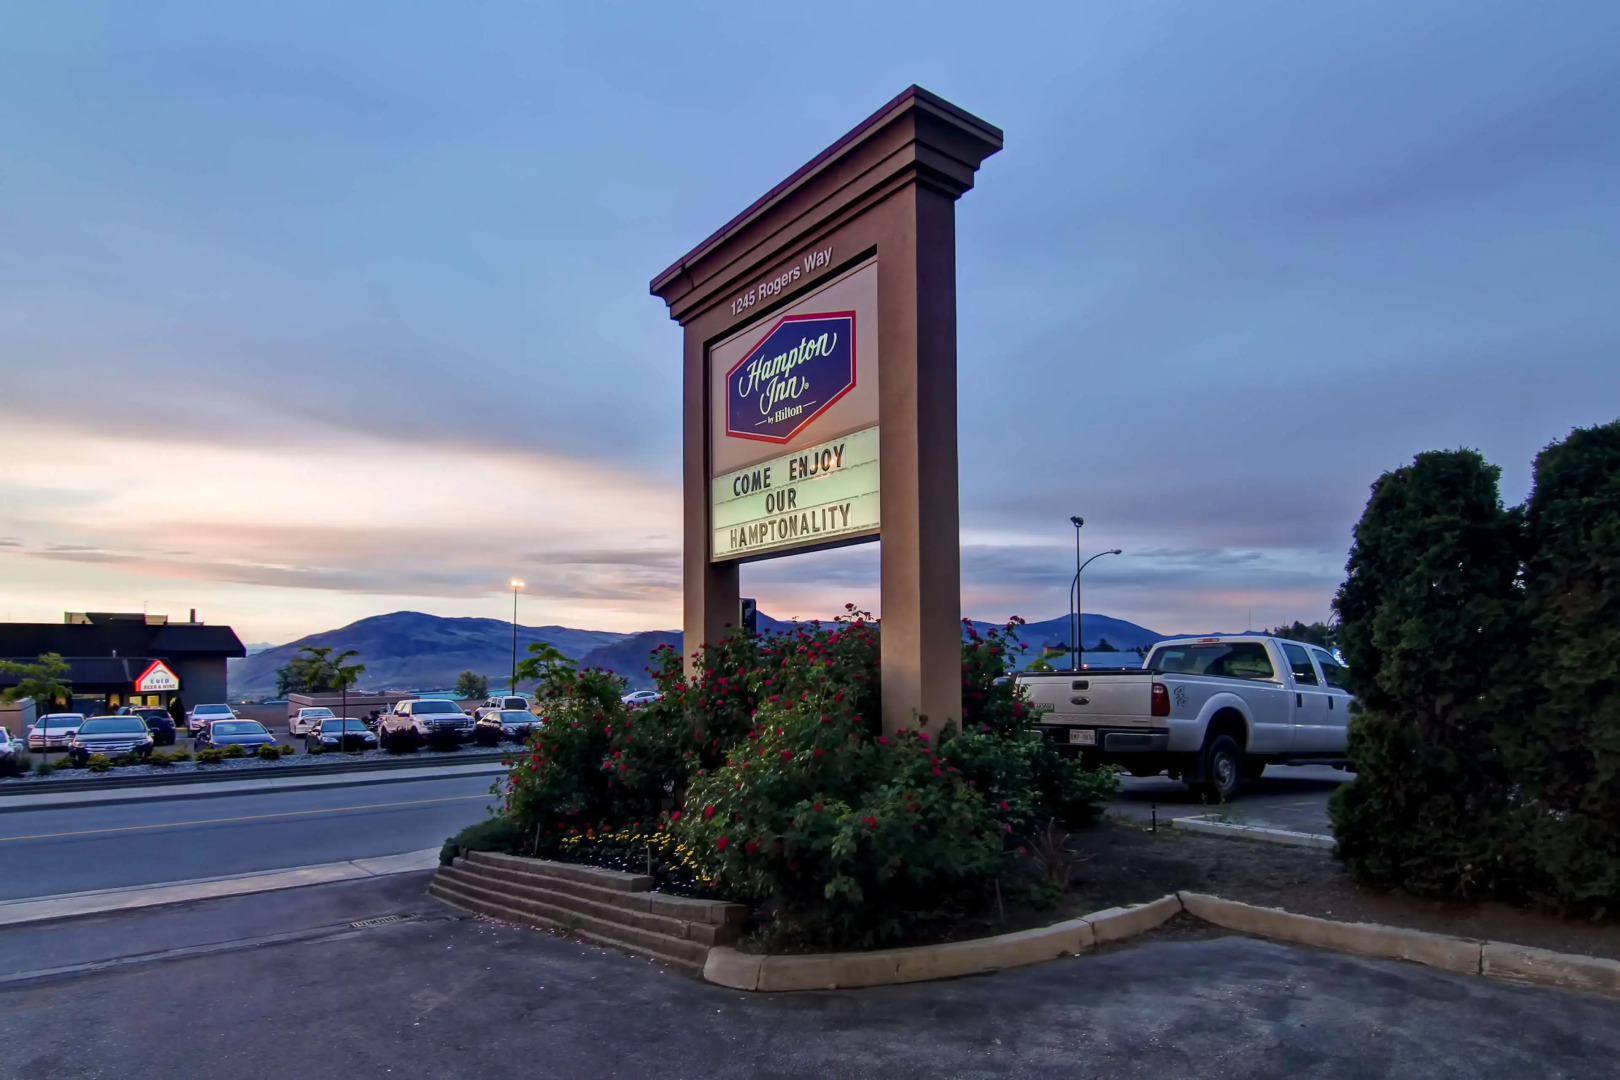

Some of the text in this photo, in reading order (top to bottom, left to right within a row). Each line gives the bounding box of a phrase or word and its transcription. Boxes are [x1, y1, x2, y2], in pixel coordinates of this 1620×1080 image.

[731, 247, 833, 316] 1245 Rogers Way
[738, 332, 837, 398] Hampton
[767, 404, 803, 424] by Hilton
[733, 443, 845, 497] COME ENJOY
[765, 487, 797, 514] OUR
[730, 503, 851, 549] HAMPTONALITY
